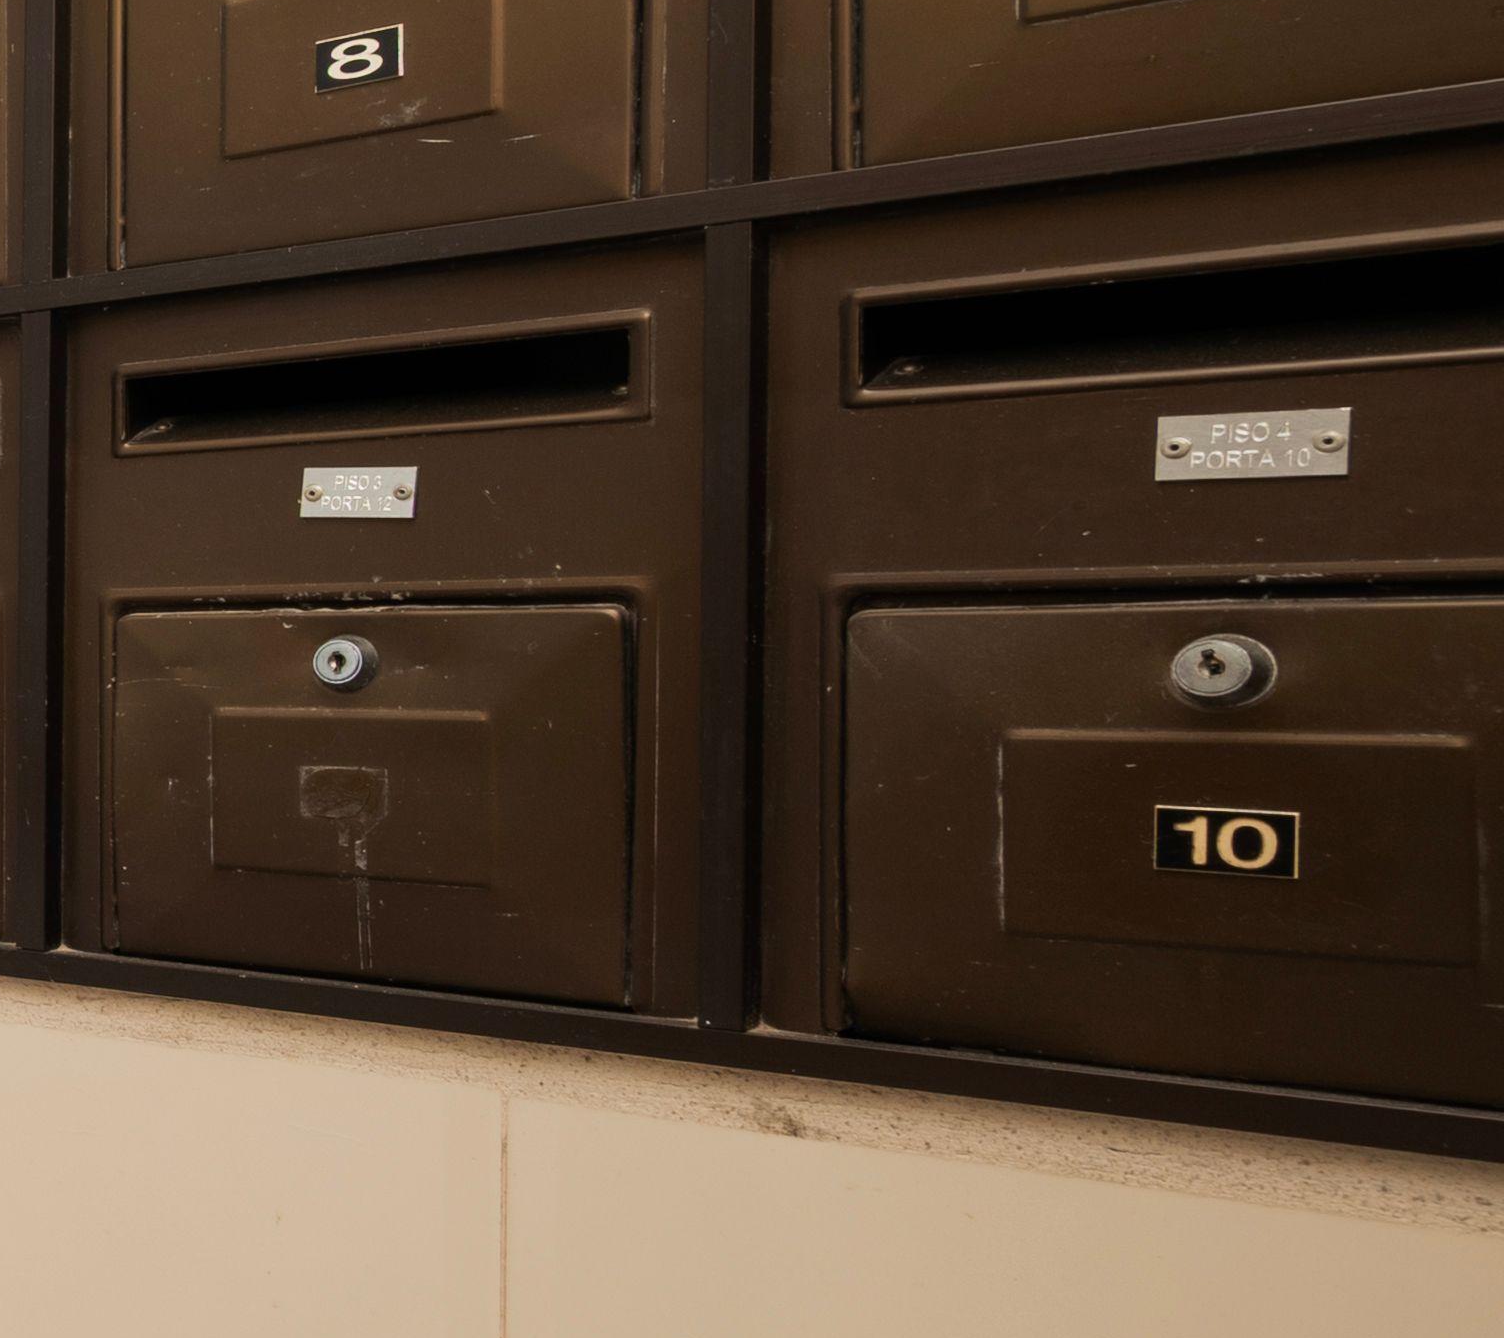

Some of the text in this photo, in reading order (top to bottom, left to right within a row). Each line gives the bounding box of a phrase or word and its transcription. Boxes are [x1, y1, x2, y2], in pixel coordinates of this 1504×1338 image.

[327, 37, 384, 80] 8
[1211, 421, 1292, 445] PISO 4
[1190, 447, 1311, 470] PORTA 10
[334, 474, 383, 491] PISO 3
[320, 495, 392, 512] PORTA 12
[1173, 816, 1279, 870] 10
